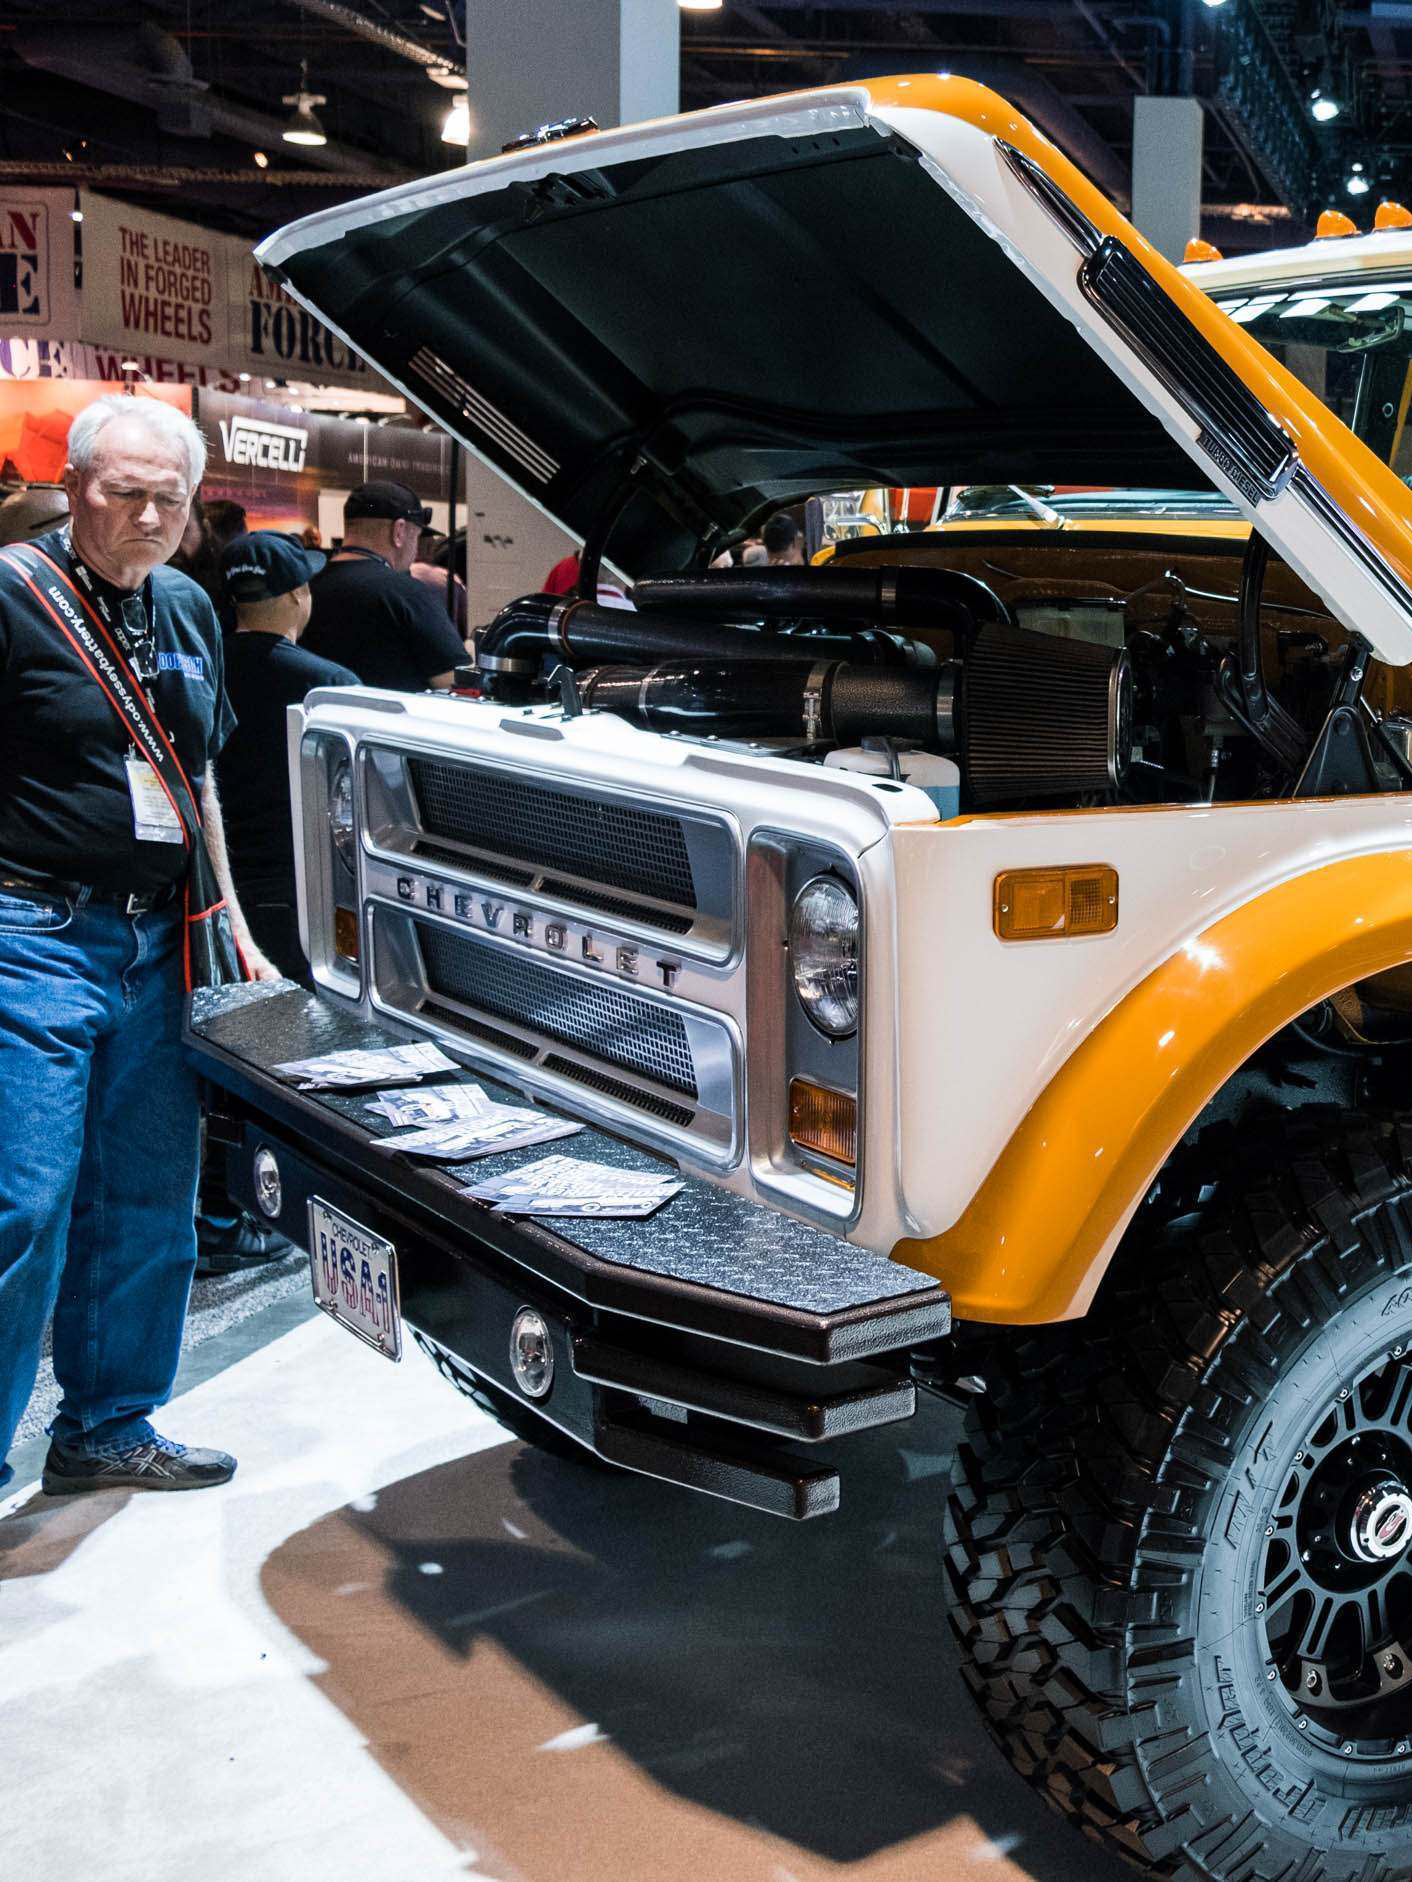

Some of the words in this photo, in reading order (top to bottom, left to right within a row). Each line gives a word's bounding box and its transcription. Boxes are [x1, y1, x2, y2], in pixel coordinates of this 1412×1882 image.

[118, 225, 149, 260] THE
[154, 238, 211, 277] LEADER
[120, 256, 138, 289] IN
[144, 262, 212, 306] FORGED
[120, 288, 213, 345] WHEELS
[1229, 464, 1260, 502] DIESEL
[48, 586, 164, 762] www.odysseybattery.com
[396, 876, 682, 990] CHEVROLET
[320, 1230, 391, 1334] USA-1
